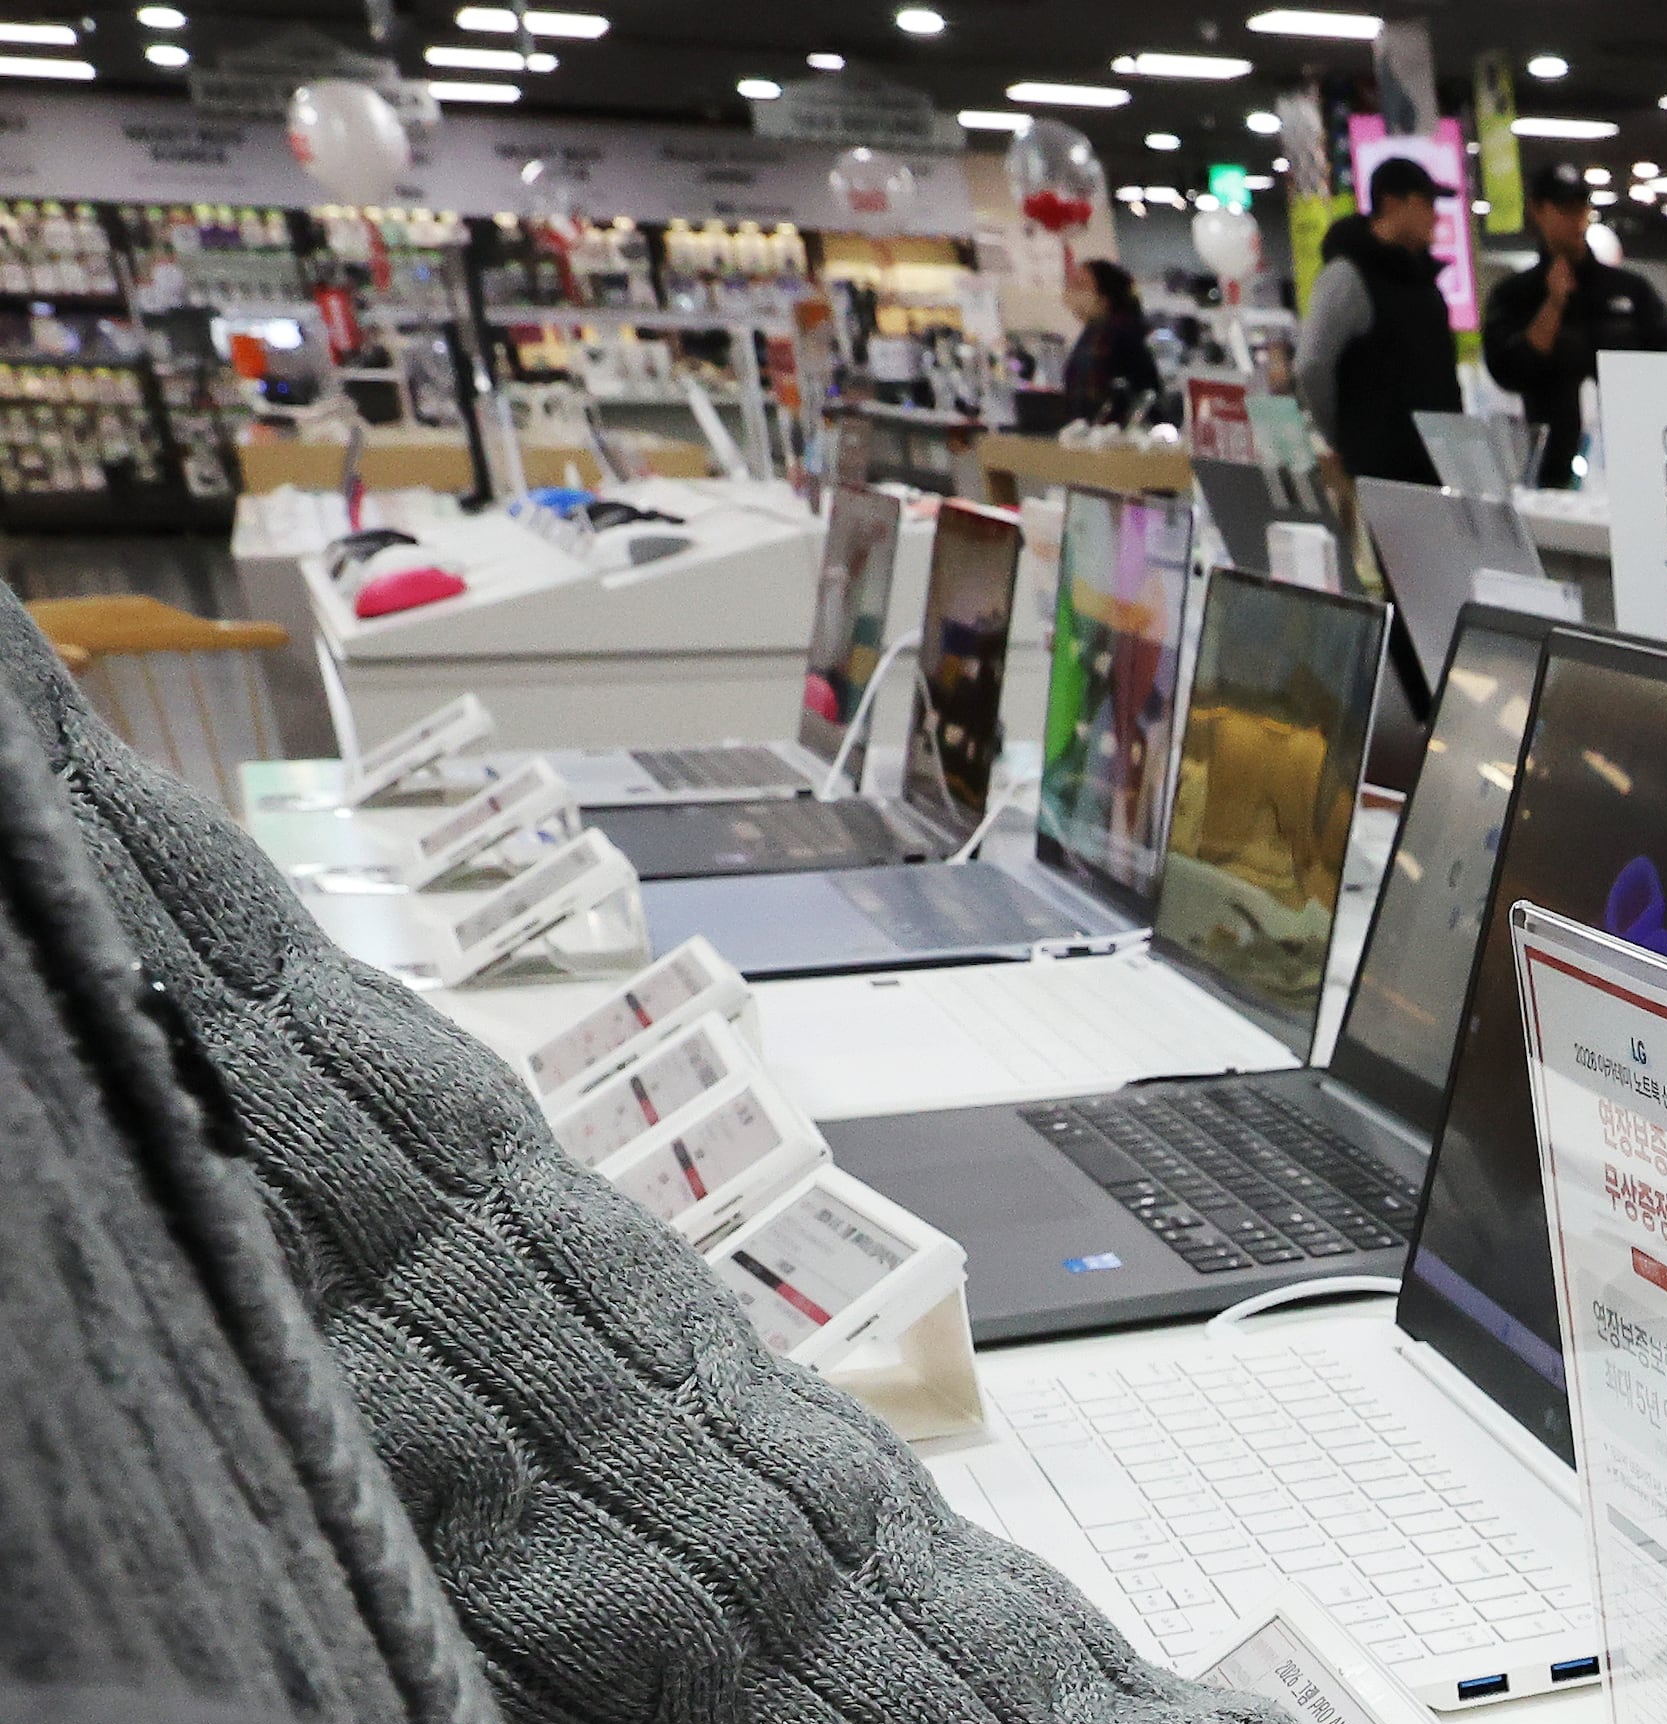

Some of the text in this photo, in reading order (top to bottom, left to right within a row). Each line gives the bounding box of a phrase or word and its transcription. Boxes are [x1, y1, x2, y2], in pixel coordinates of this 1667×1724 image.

[1630, 1036, 1648, 1065] LG
[1633, 1071, 1661, 1106] 노트북
[1273, 1658, 1304, 1689] 2026
[1290, 1678, 1322, 1707] 그램
[1310, 1695, 1336, 1724] PRO
